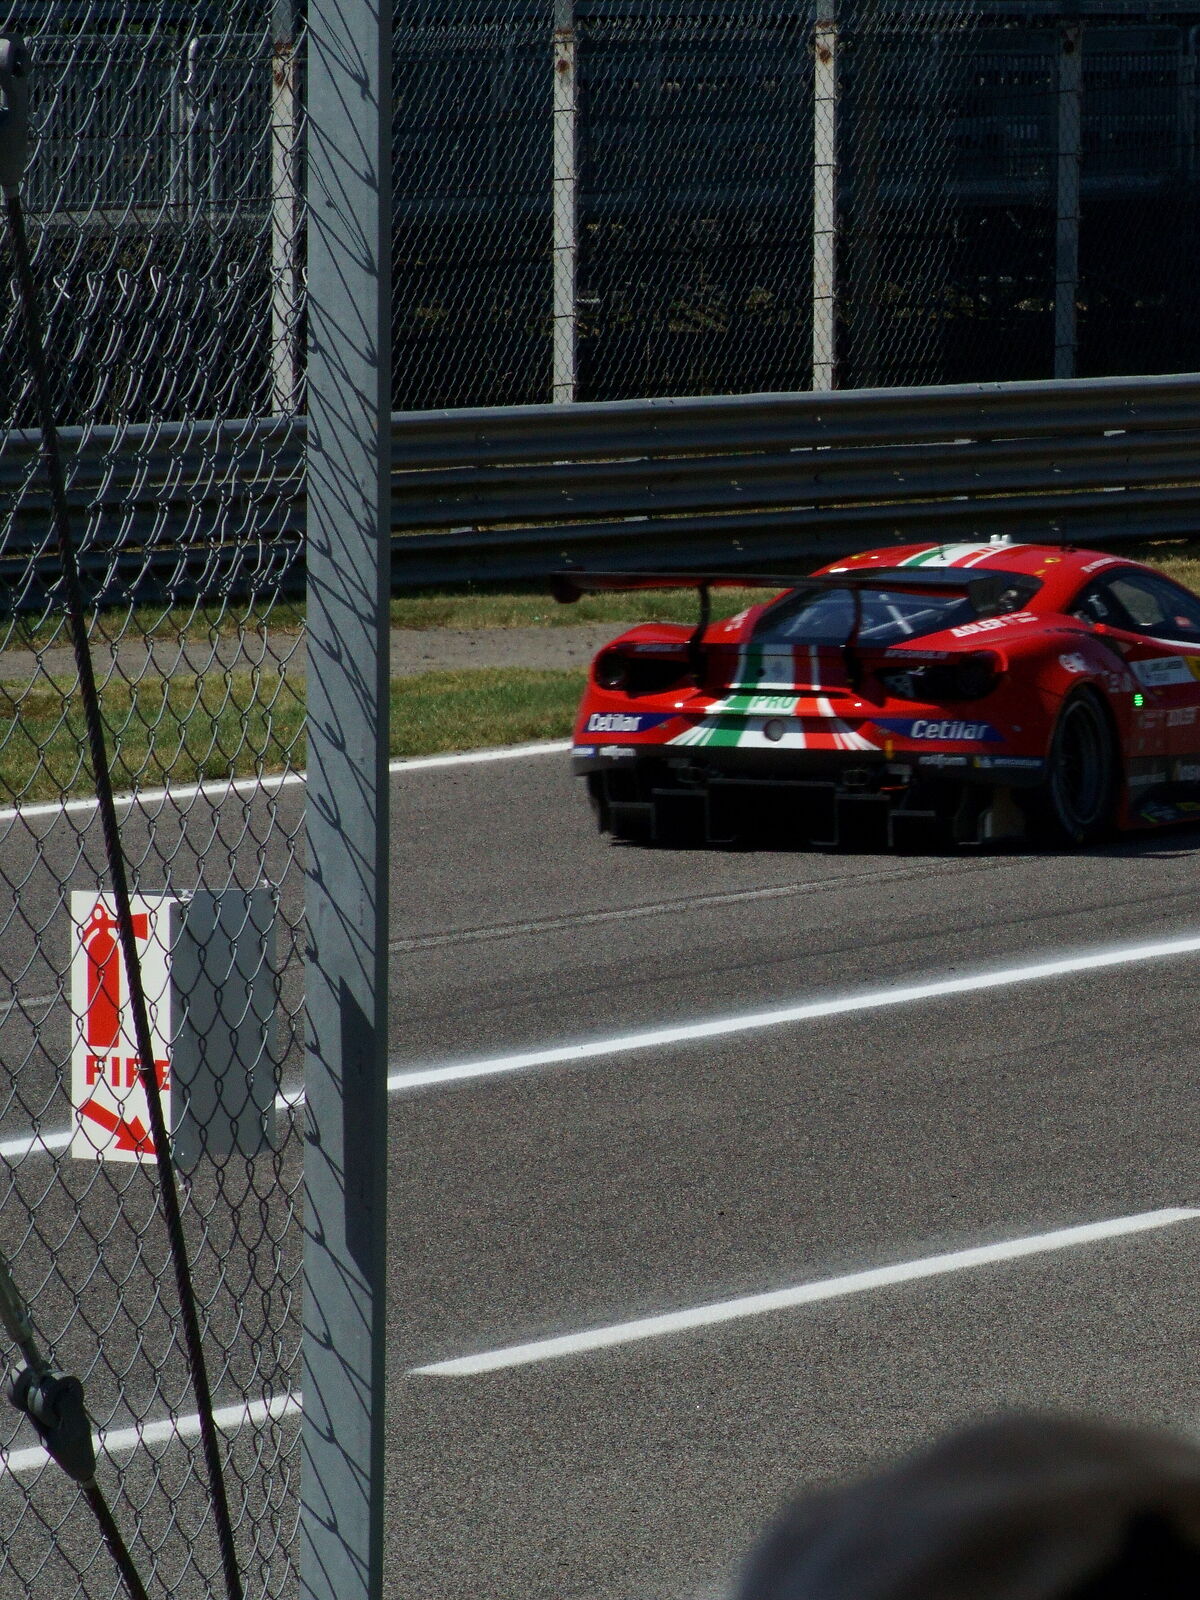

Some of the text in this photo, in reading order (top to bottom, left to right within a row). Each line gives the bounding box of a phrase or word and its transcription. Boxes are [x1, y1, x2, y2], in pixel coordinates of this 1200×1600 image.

[752, 695, 796, 709] PRO
[587, 713, 643, 731] Cetilar
[909, 719, 990, 740] Cetilar
[86, 1055, 170, 1090] FIRE
